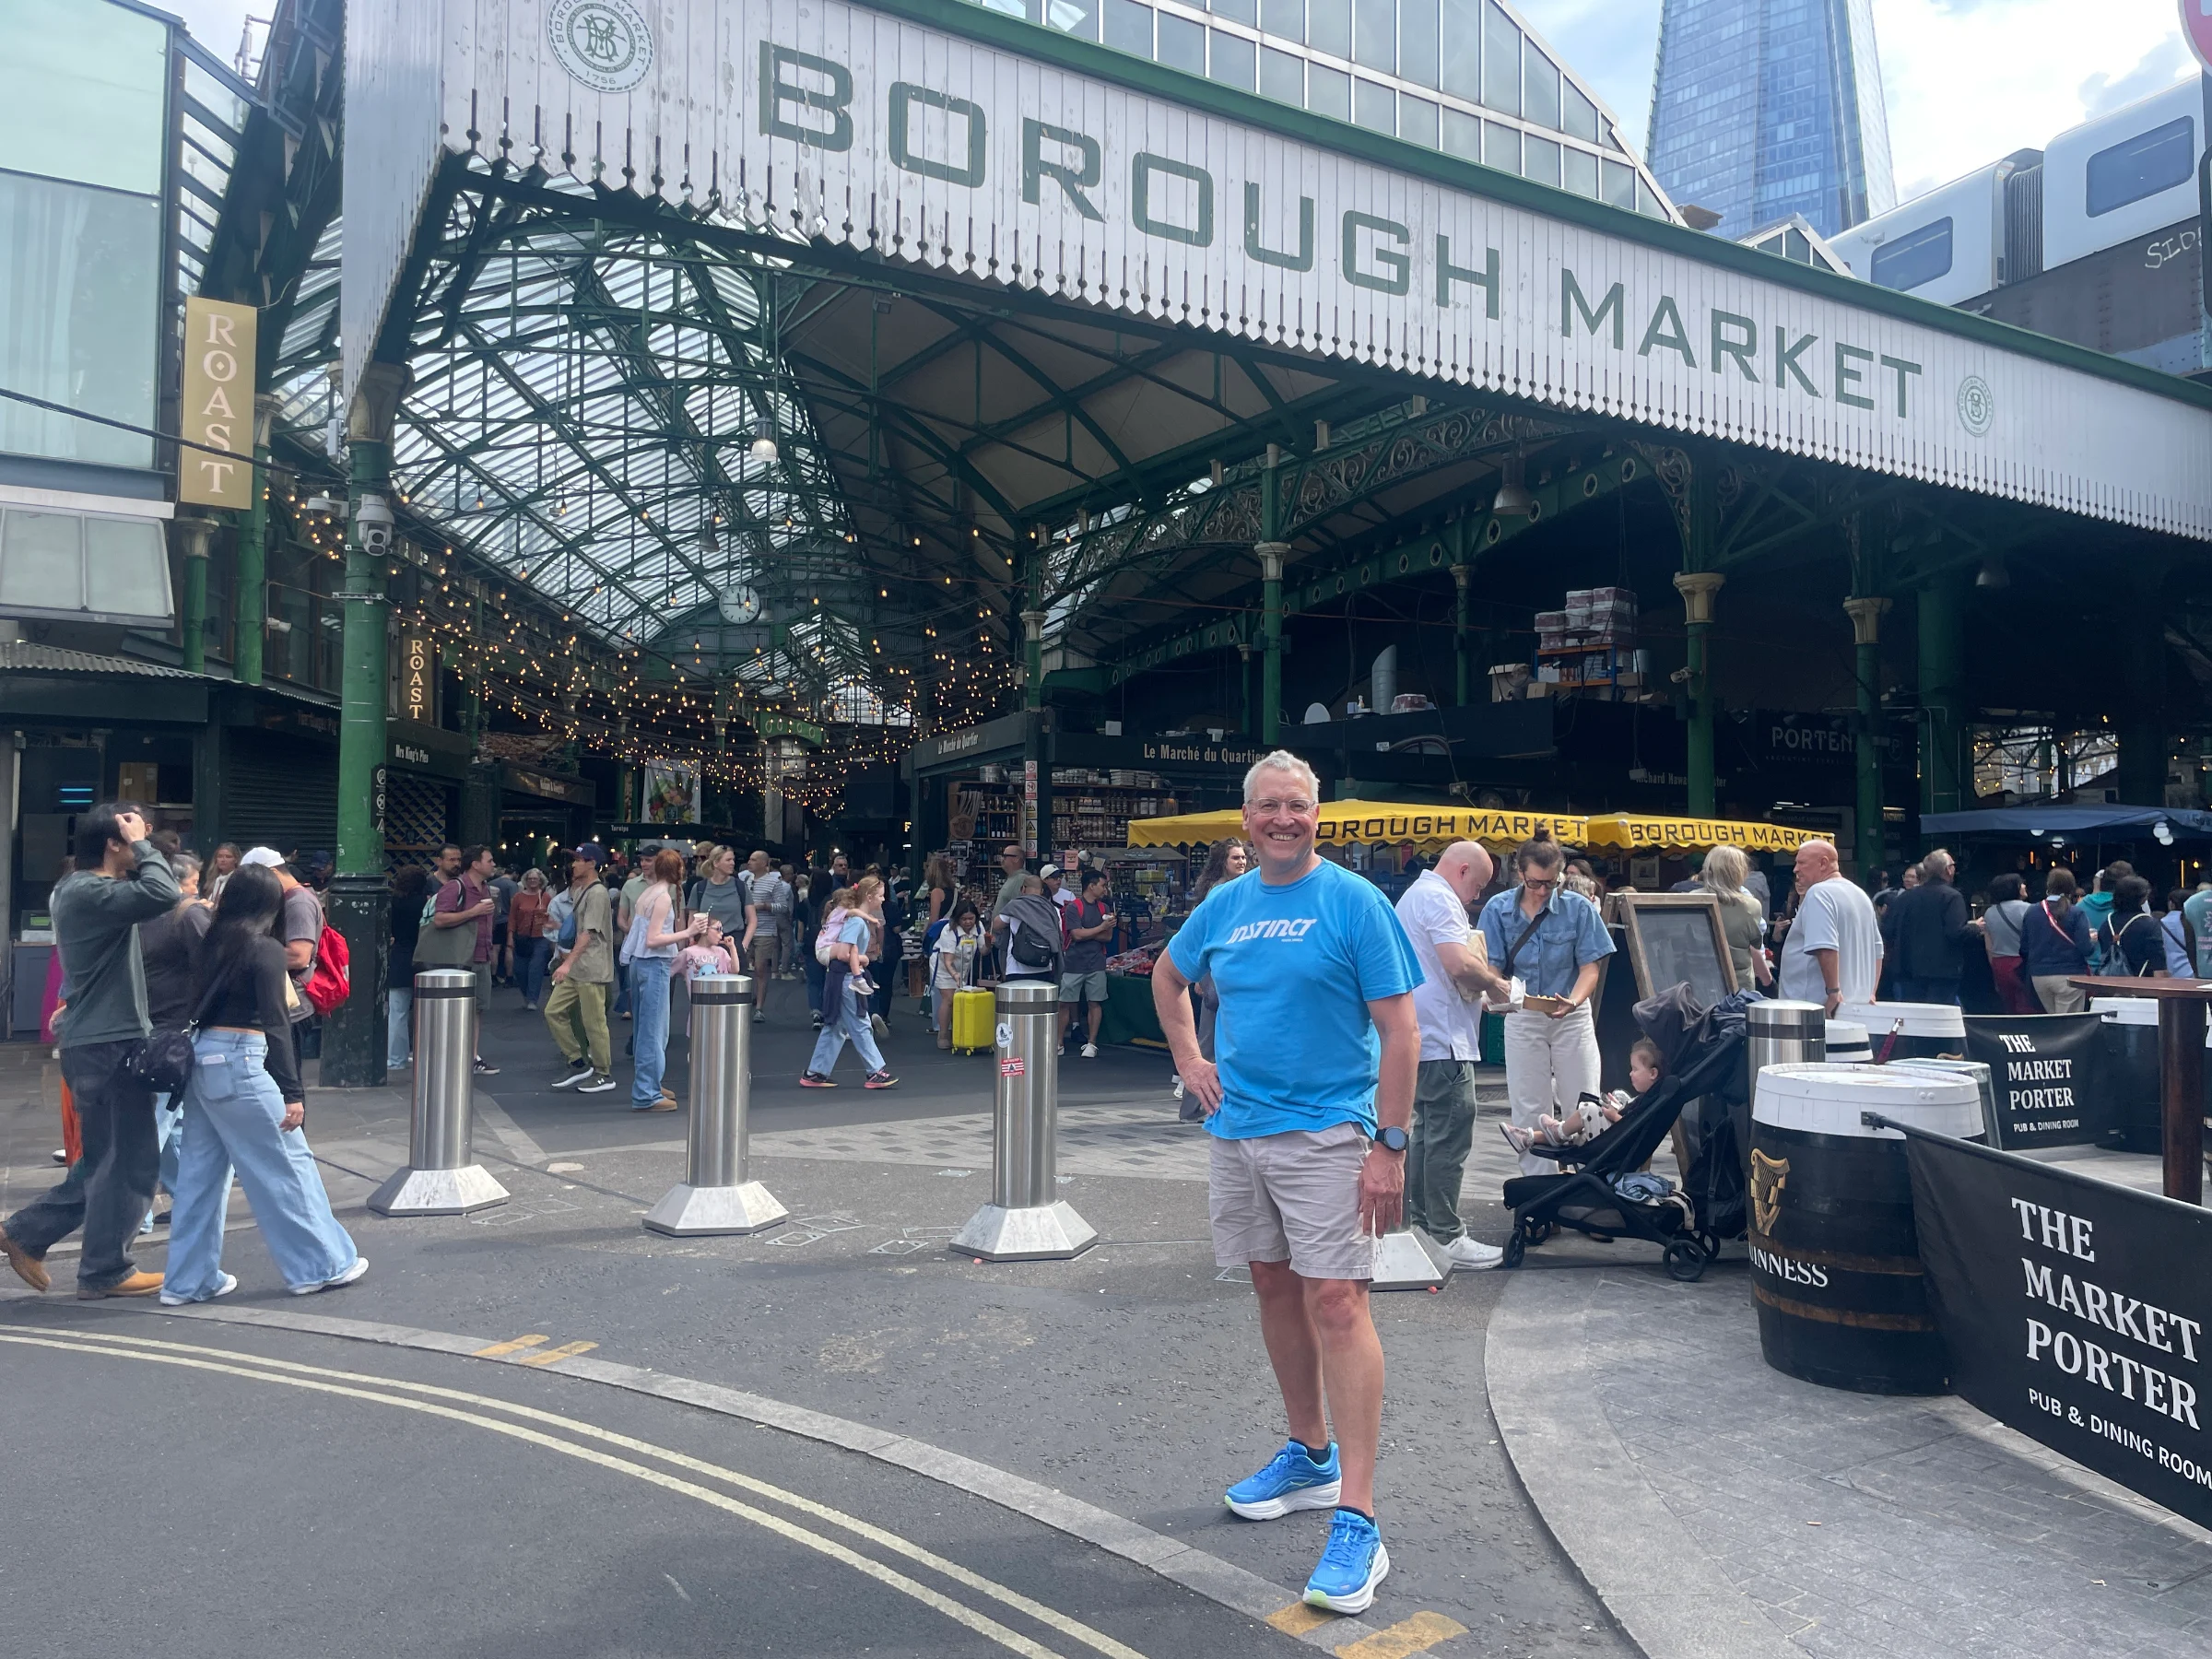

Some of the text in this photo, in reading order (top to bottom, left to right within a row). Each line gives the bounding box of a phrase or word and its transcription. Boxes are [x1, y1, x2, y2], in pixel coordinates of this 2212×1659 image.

[613, 2, 647, 65] MARKET
[586, 70, 617, 85] 1756
[759, 39, 1923, 419] BOROUGH MARKET
[200, 313, 237, 493] ROAST
[409, 640, 424, 719] ROAST
[395, 744, 405, 759] Mrs
[1144, 743, 1156, 759] Le
[1160, 745, 1200, 761] Marché
[1204, 747, 1218, 762] du
[1771, 726, 1854, 753] PORTEN
[1315, 816, 1455, 840] OROUGH
[1630, 824, 1747, 841] BOROUGH
[1224, 918, 1318, 945] INSTINCT
[1998, 1034, 2036, 1053] THE
[2006, 1059, 2072, 1081] MARKET
[2008, 1087, 2075, 1111] PORTER
[2013, 1119, 2079, 1133] PUB & DINING ROOM
[2011, 1196, 2096, 1264] THE
[2020, 1256, 2202, 1364] MARKET
[2026, 1317, 2201, 1431] PORTER
[2029, 1386, 2212, 1490] PUB & DINING ROOM
